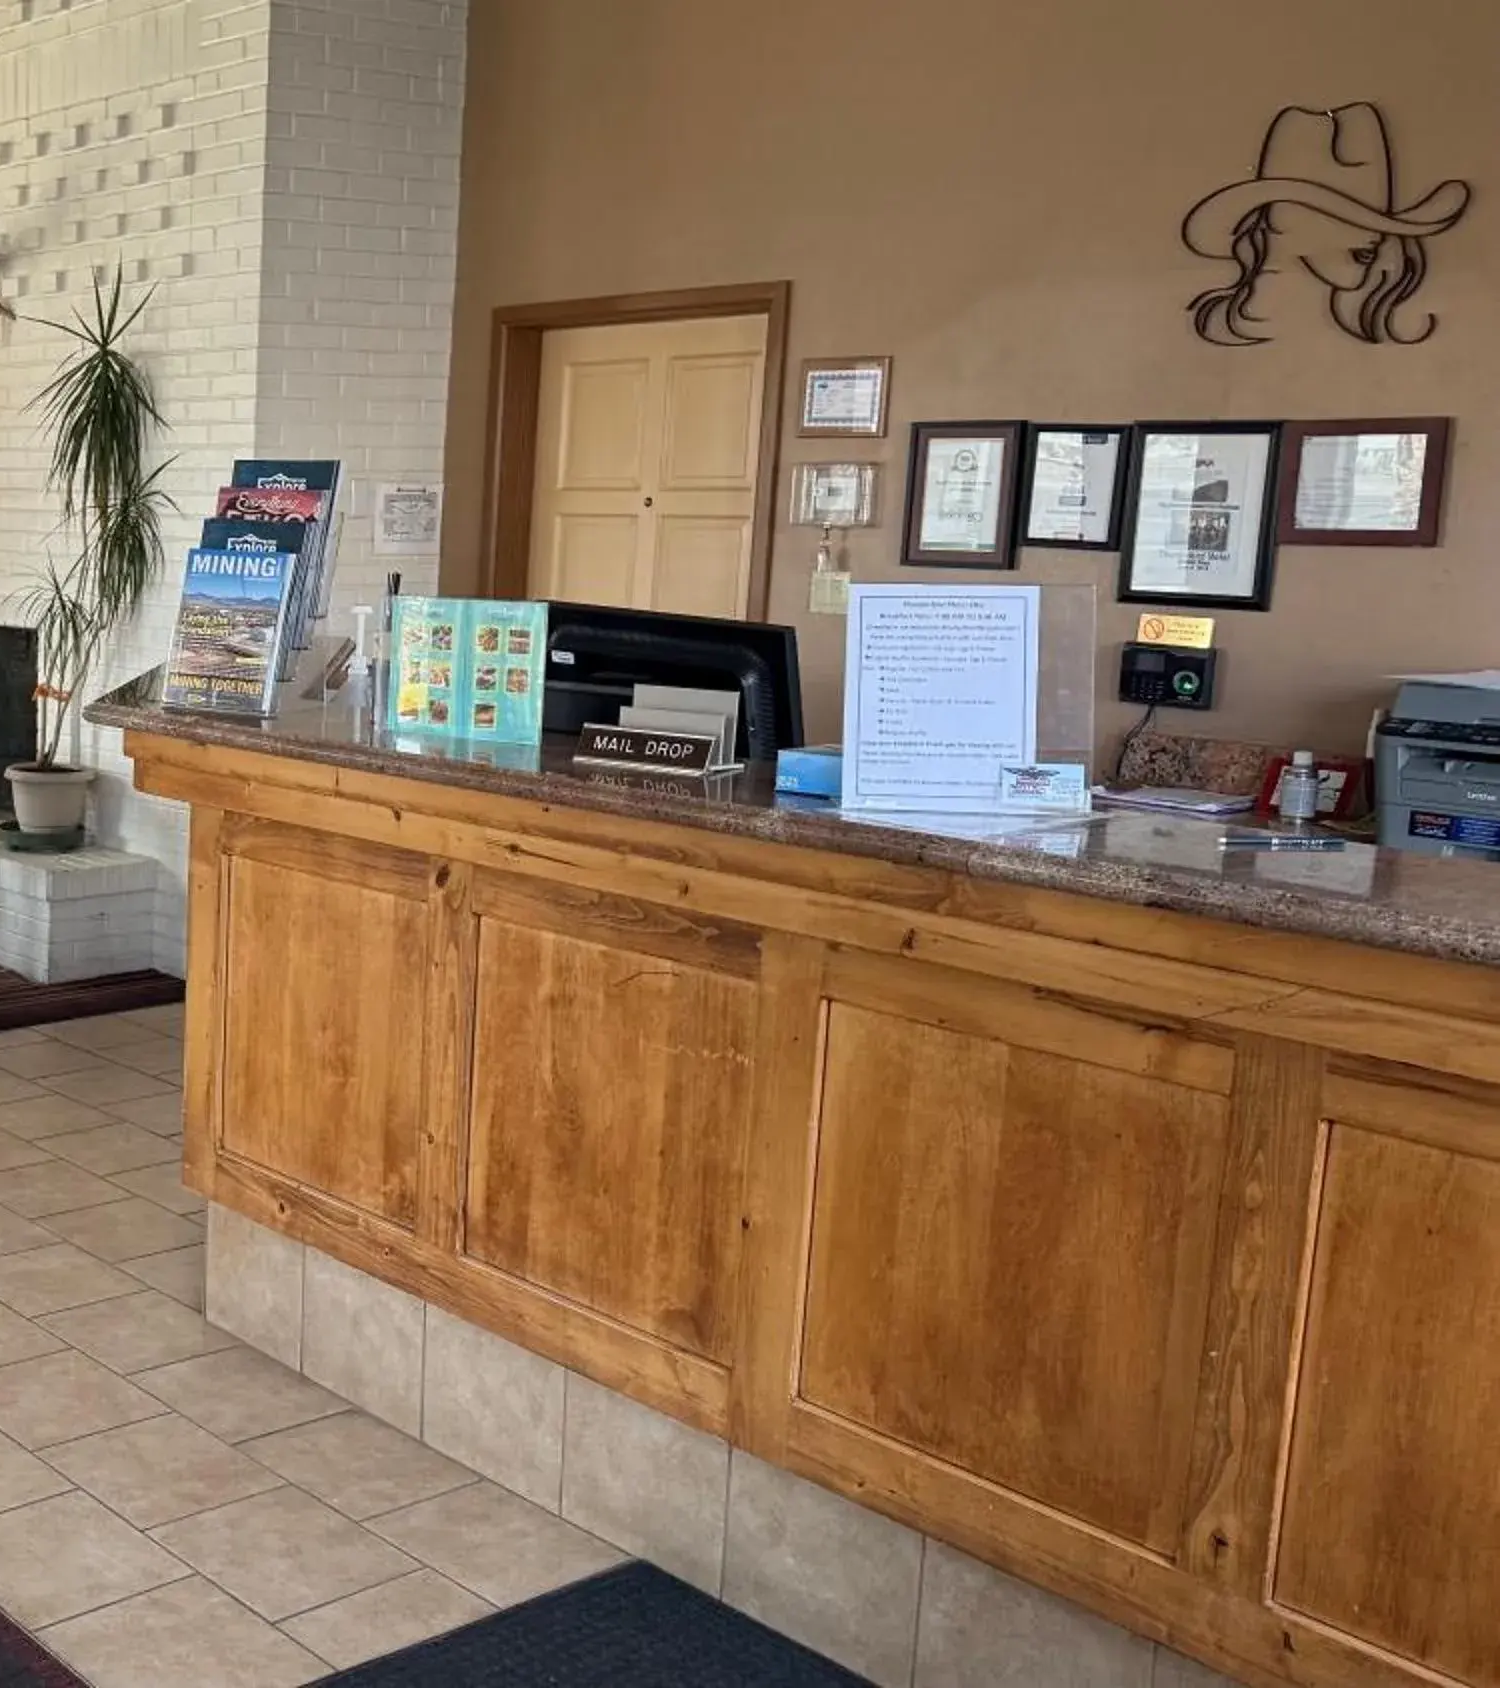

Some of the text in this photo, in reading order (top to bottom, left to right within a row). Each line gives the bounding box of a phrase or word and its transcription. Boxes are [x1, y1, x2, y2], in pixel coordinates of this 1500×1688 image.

[191, 554, 277, 577] MINING
[593, 735, 694, 759] MAIL DROP
